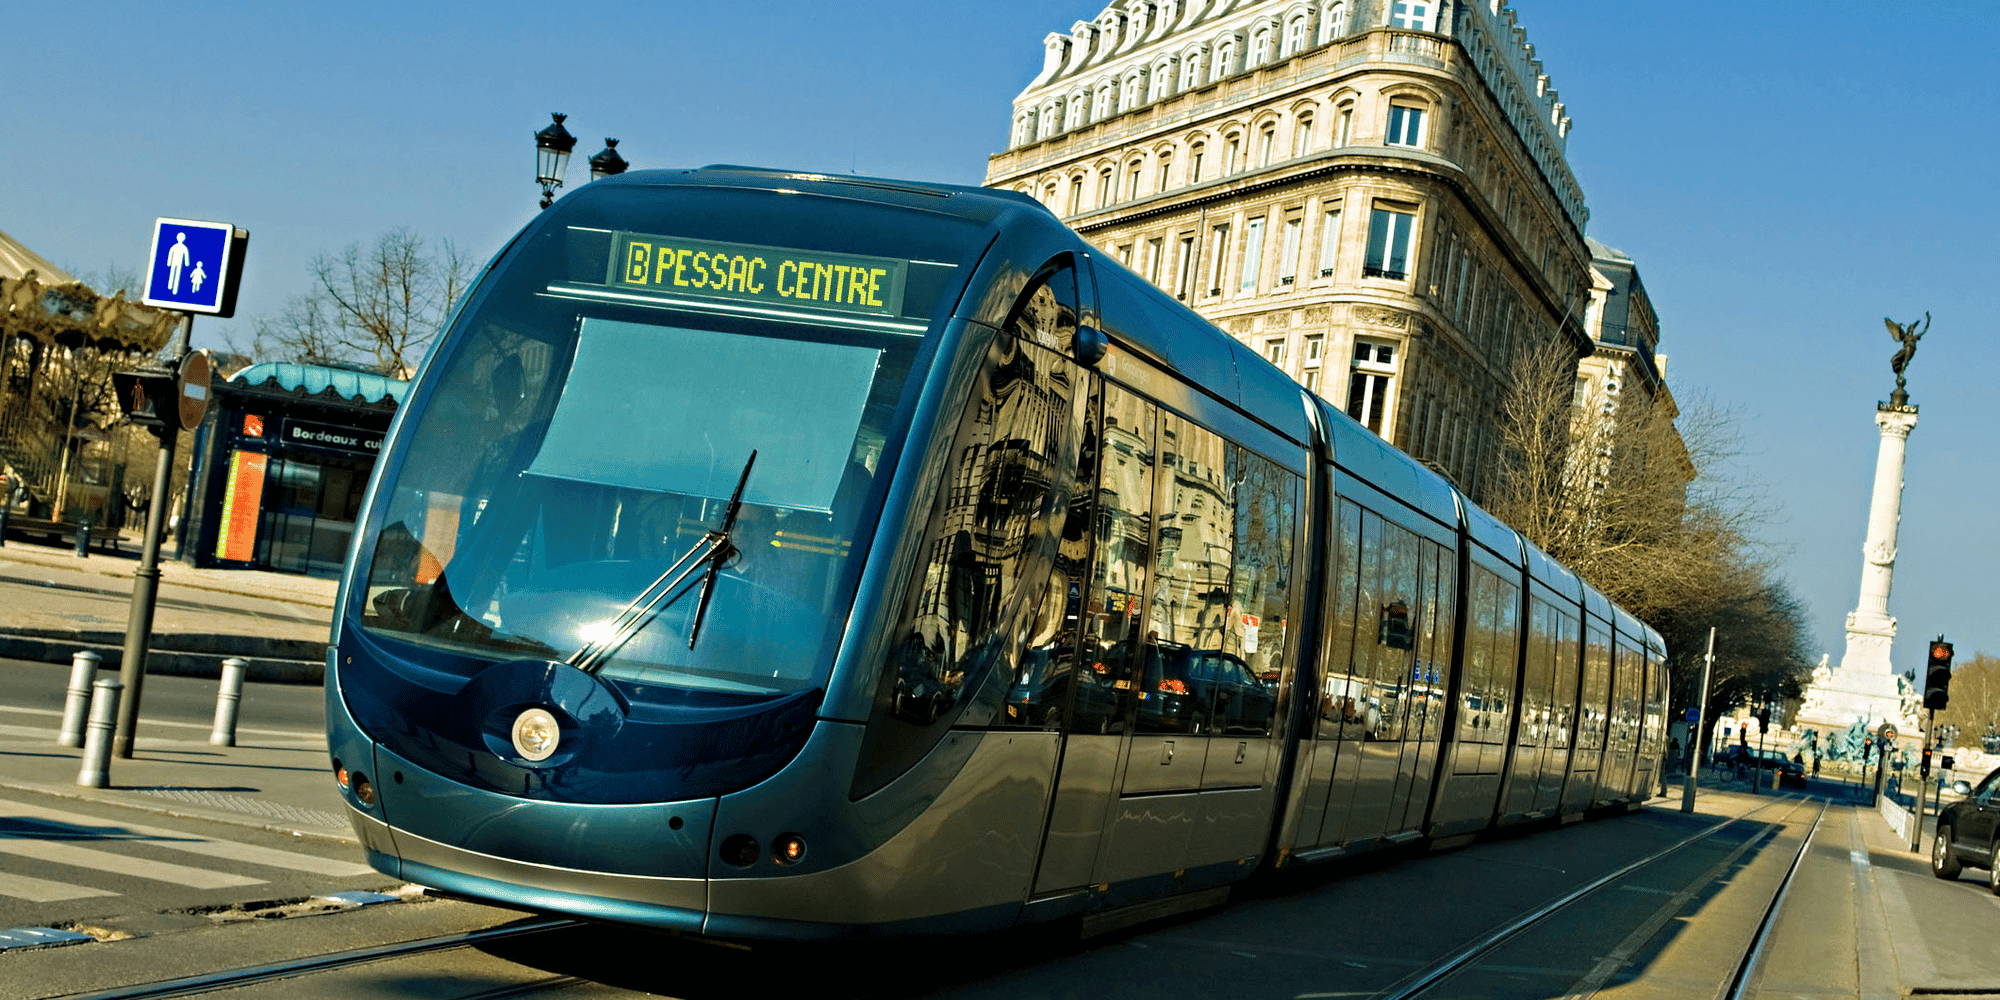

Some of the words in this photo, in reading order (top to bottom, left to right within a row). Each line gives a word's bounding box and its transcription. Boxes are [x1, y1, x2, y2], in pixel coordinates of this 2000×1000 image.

[626, 242, 651, 284] B
[655, 247, 767, 294] PESSAC
[777, 260, 887, 306] CENTRE
[292, 427, 358, 446] Bordeaux
